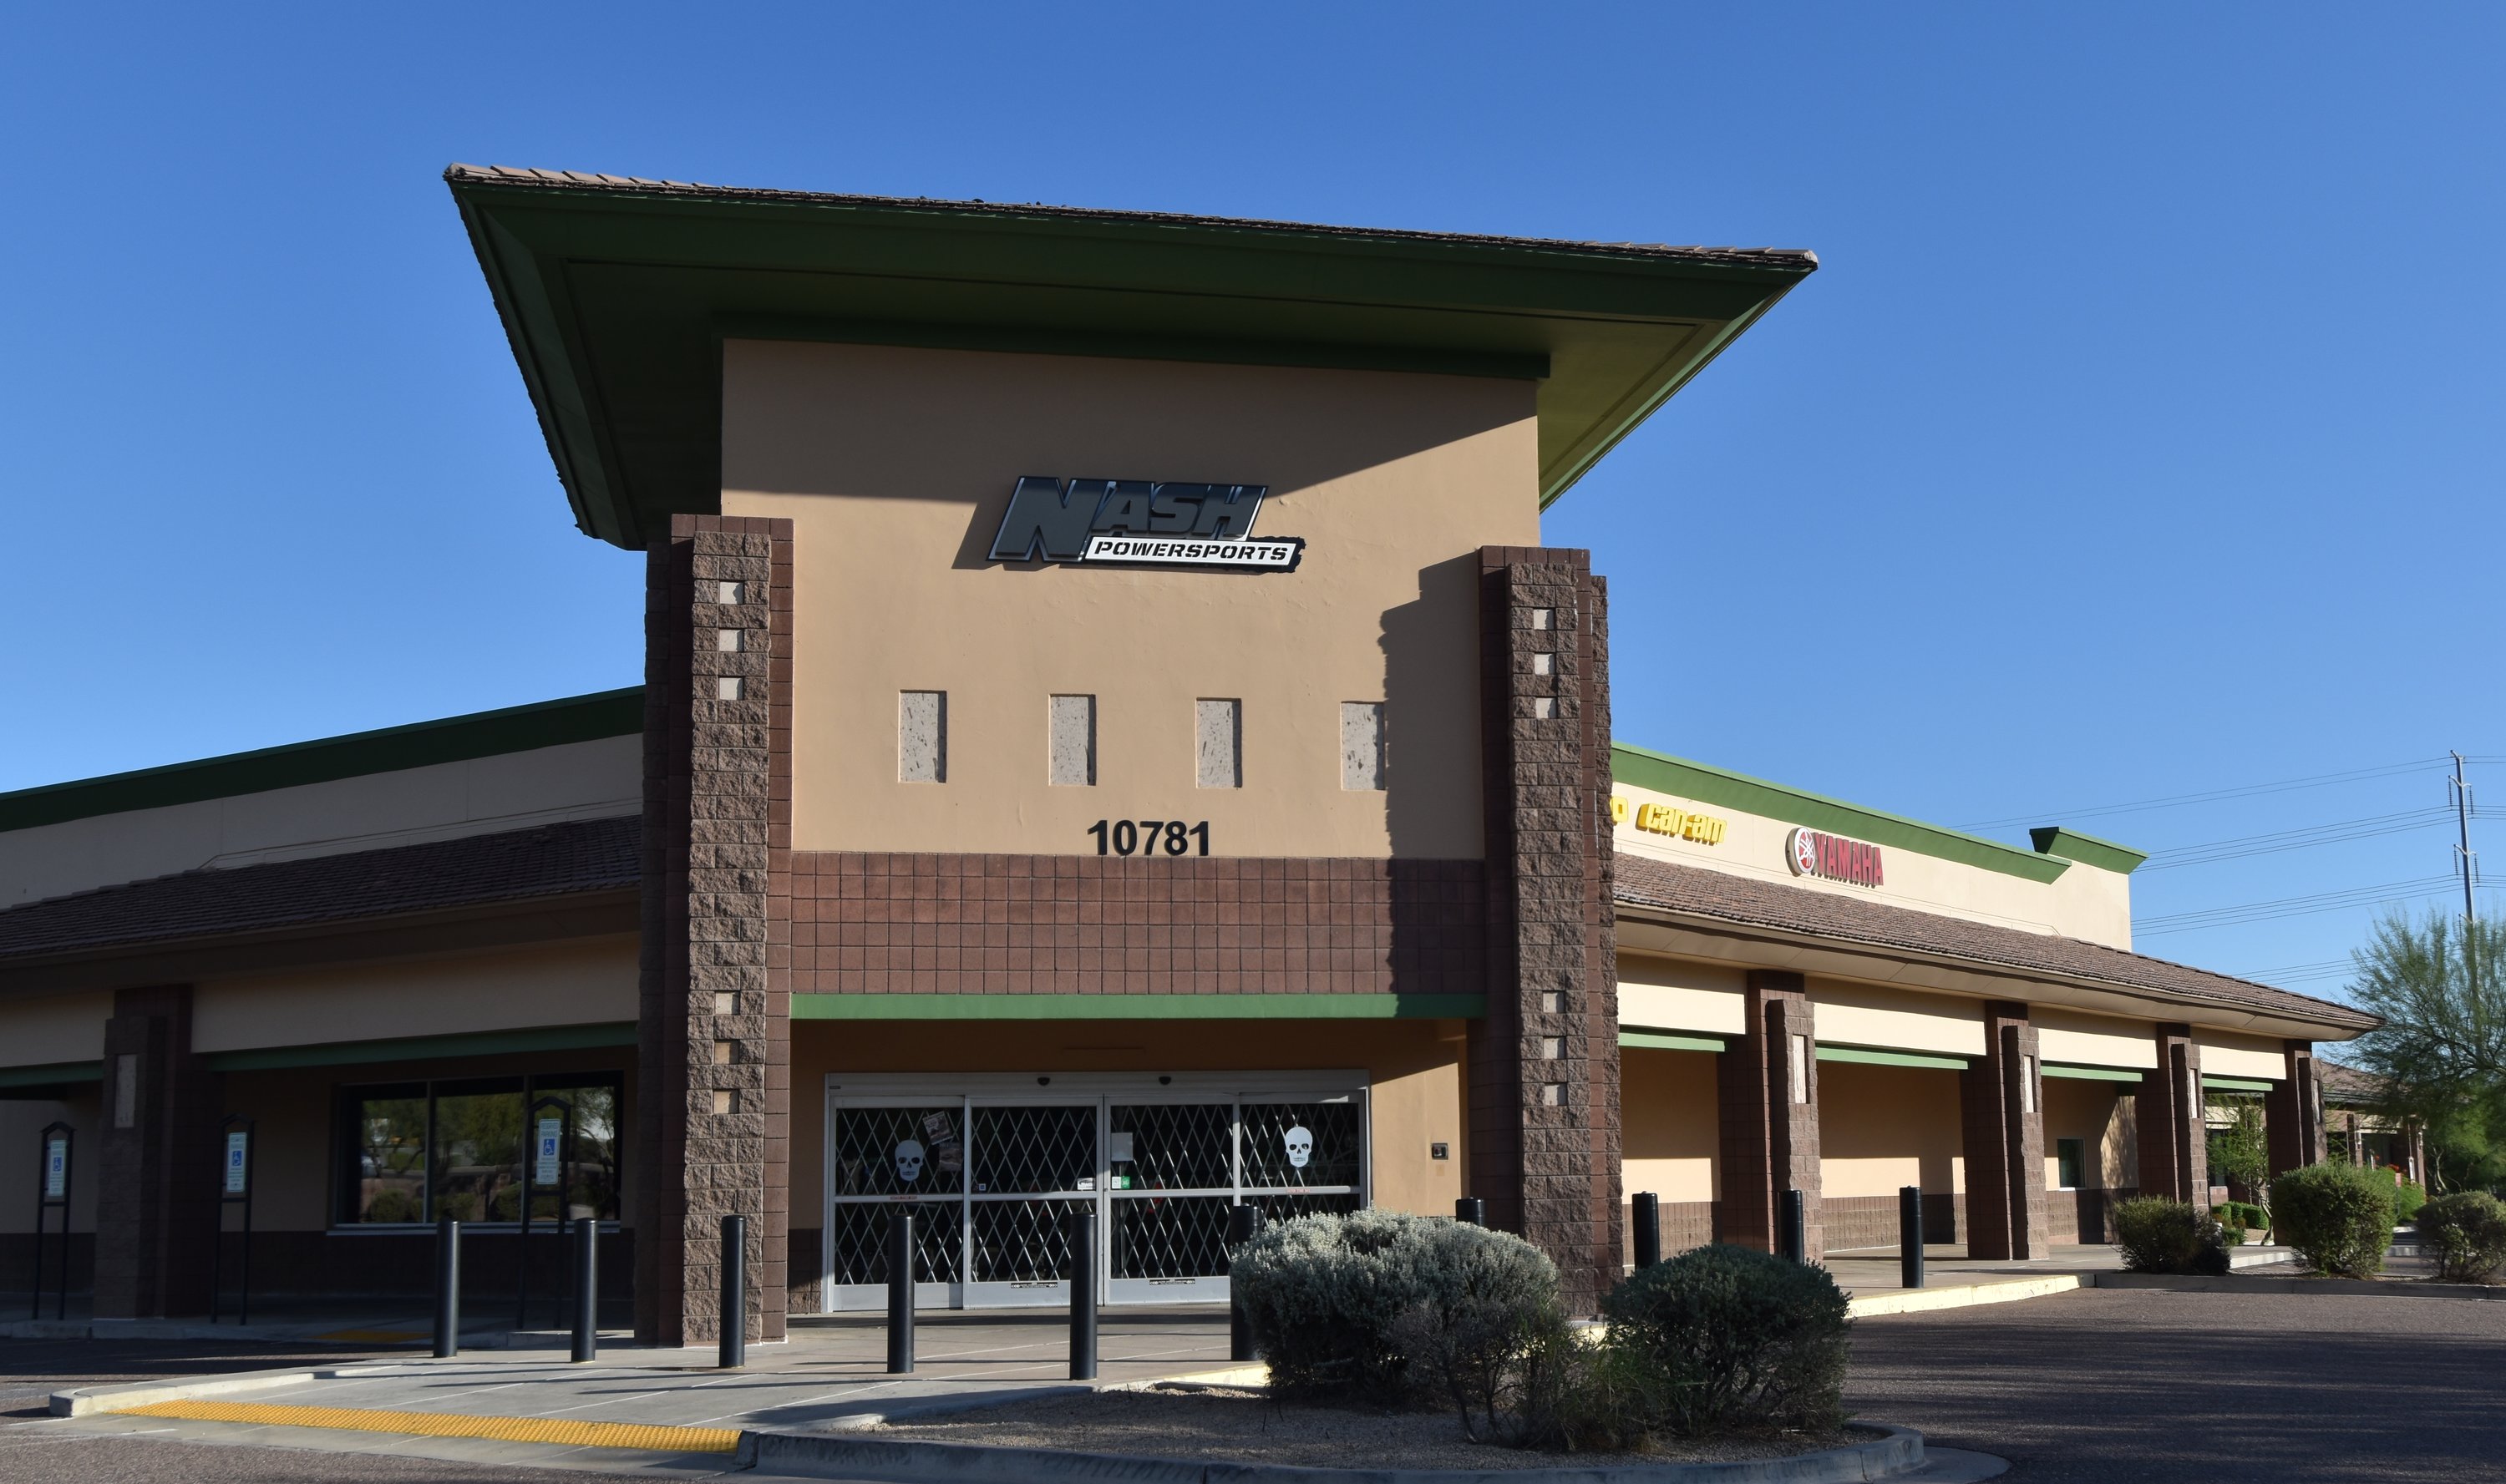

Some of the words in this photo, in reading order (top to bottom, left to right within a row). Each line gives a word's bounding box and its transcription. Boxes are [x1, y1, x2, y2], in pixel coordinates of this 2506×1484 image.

[987, 475, 1268, 562] NASH
[1093, 540, 1289, 561] POWERSPORTS
[1087, 819, 1209, 856] 10781
[1813, 832, 1884, 886] YAMAHA
